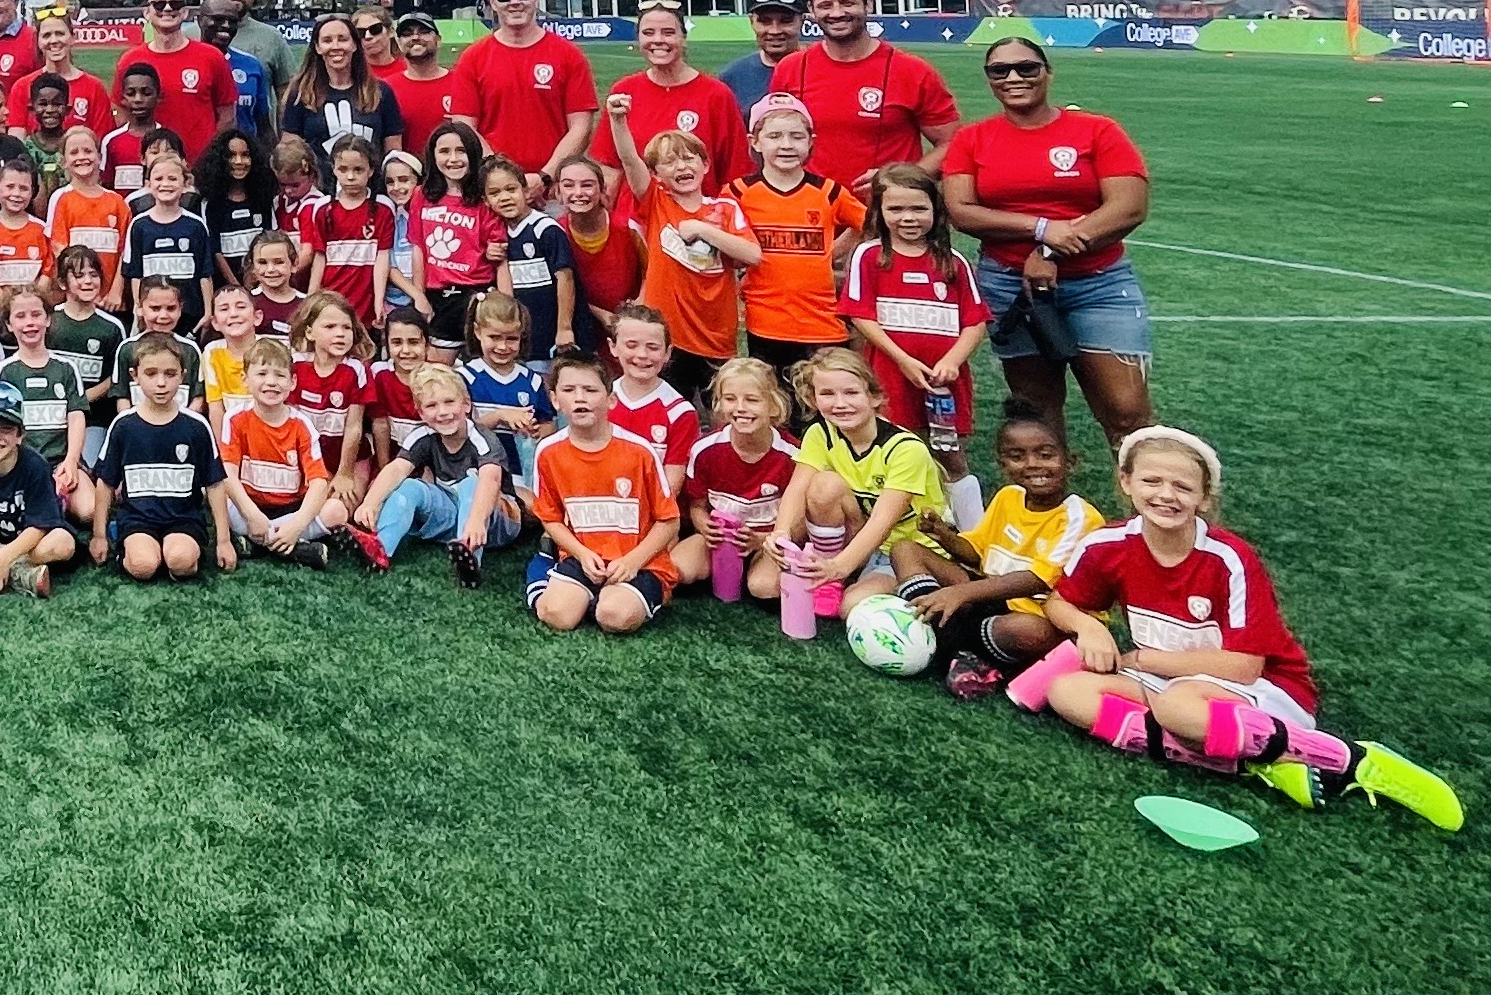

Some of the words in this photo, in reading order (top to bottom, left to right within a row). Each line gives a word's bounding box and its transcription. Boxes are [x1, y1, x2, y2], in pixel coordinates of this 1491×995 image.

[586, 24, 604, 36] AVE
[1127, 23, 1172, 46] College
[1419, 32, 1487, 60] College
[879, 303, 957, 331] SENEGAL
